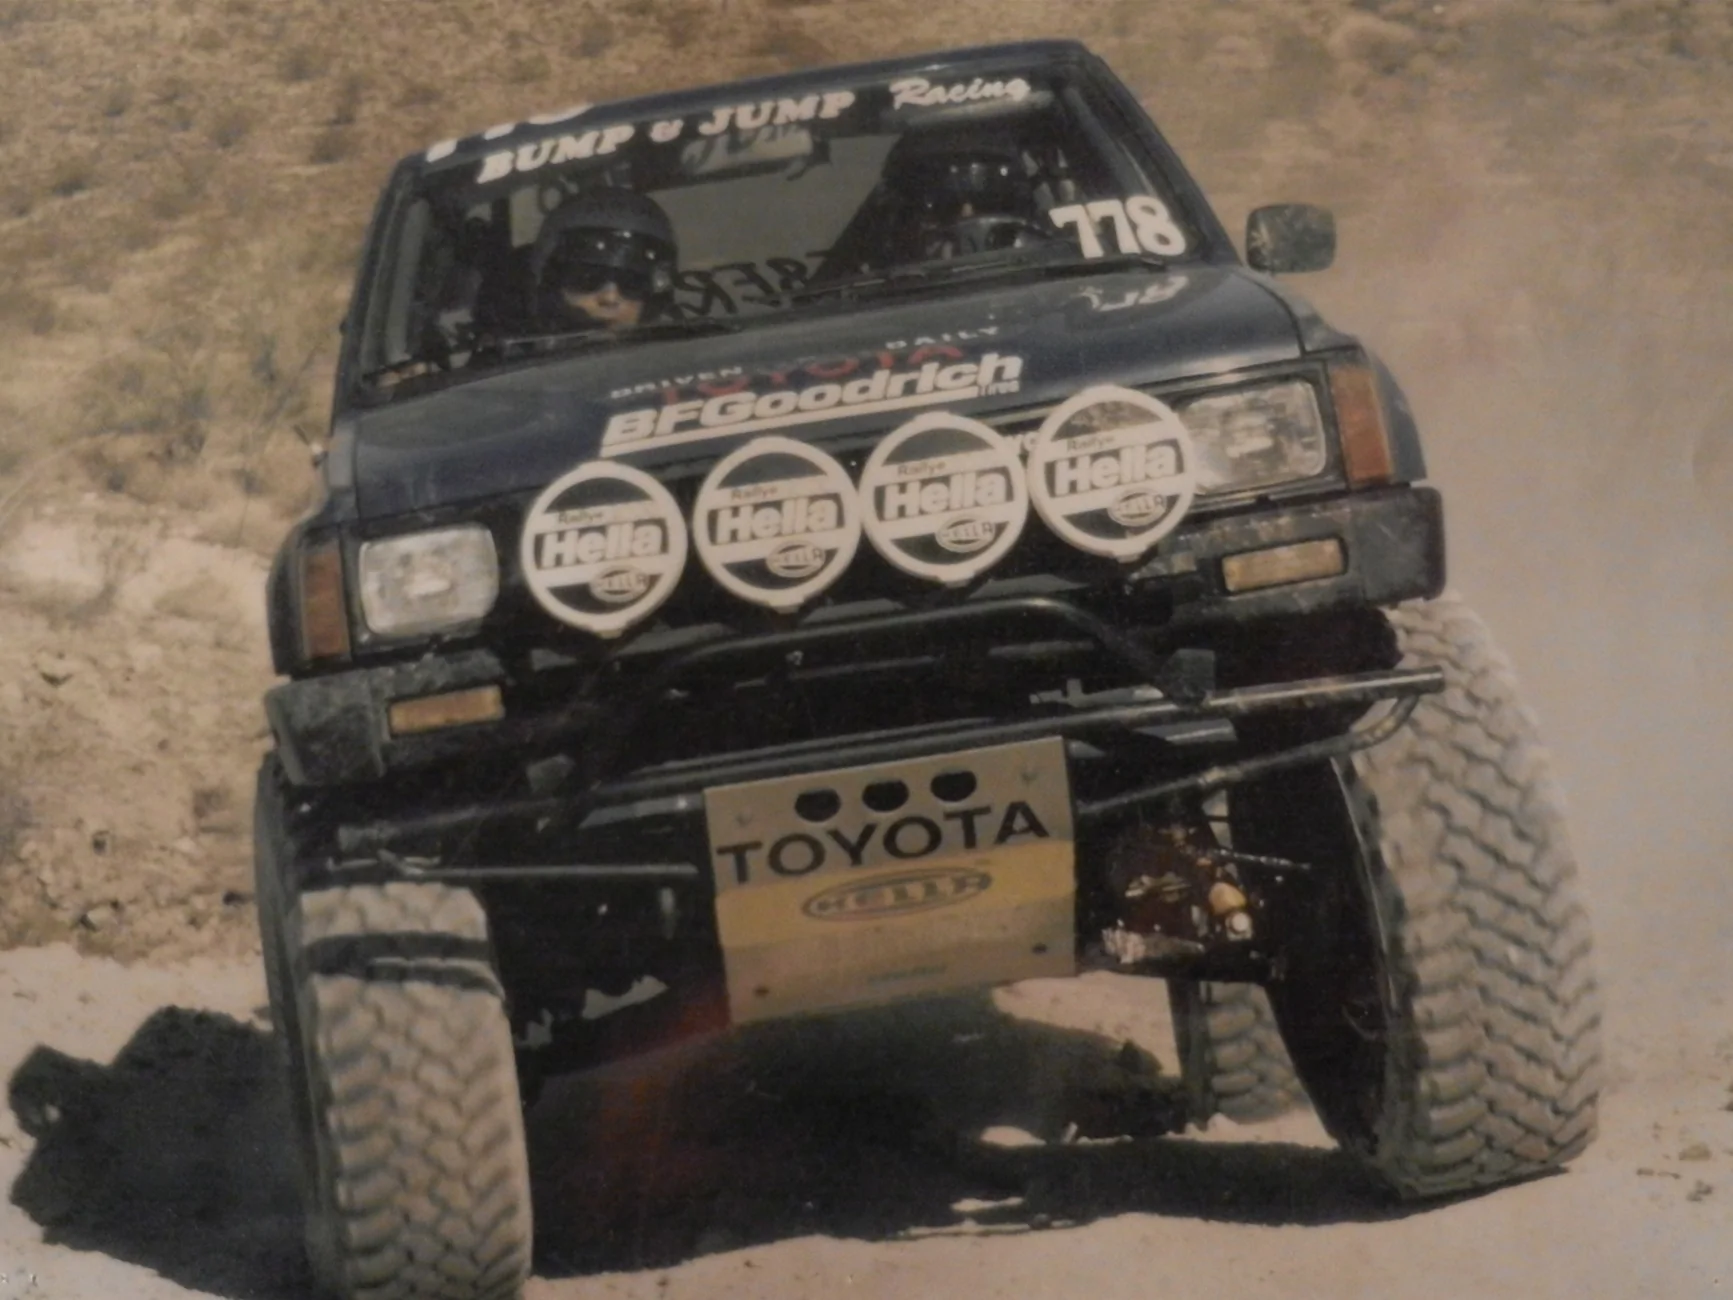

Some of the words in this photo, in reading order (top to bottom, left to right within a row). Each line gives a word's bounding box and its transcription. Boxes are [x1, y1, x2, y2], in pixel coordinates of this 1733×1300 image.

[476, 124, 635, 184] BUMP
[650, 119, 684, 142] &
[699, 91, 855, 135] JUMP
[889, 77, 1031, 110] Racing
[1048, 195, 1186, 259] 778
[602, 352, 1023, 446] BFGoodrich
[611, 366, 743, 399] DRIVEN
[1054, 443, 1176, 496] Hella
[716, 497, 839, 545] Hella
[882, 472, 1006, 521] Hella
[541, 521, 664, 569] Hella
[716, 800, 1050, 884] TOYOTA
